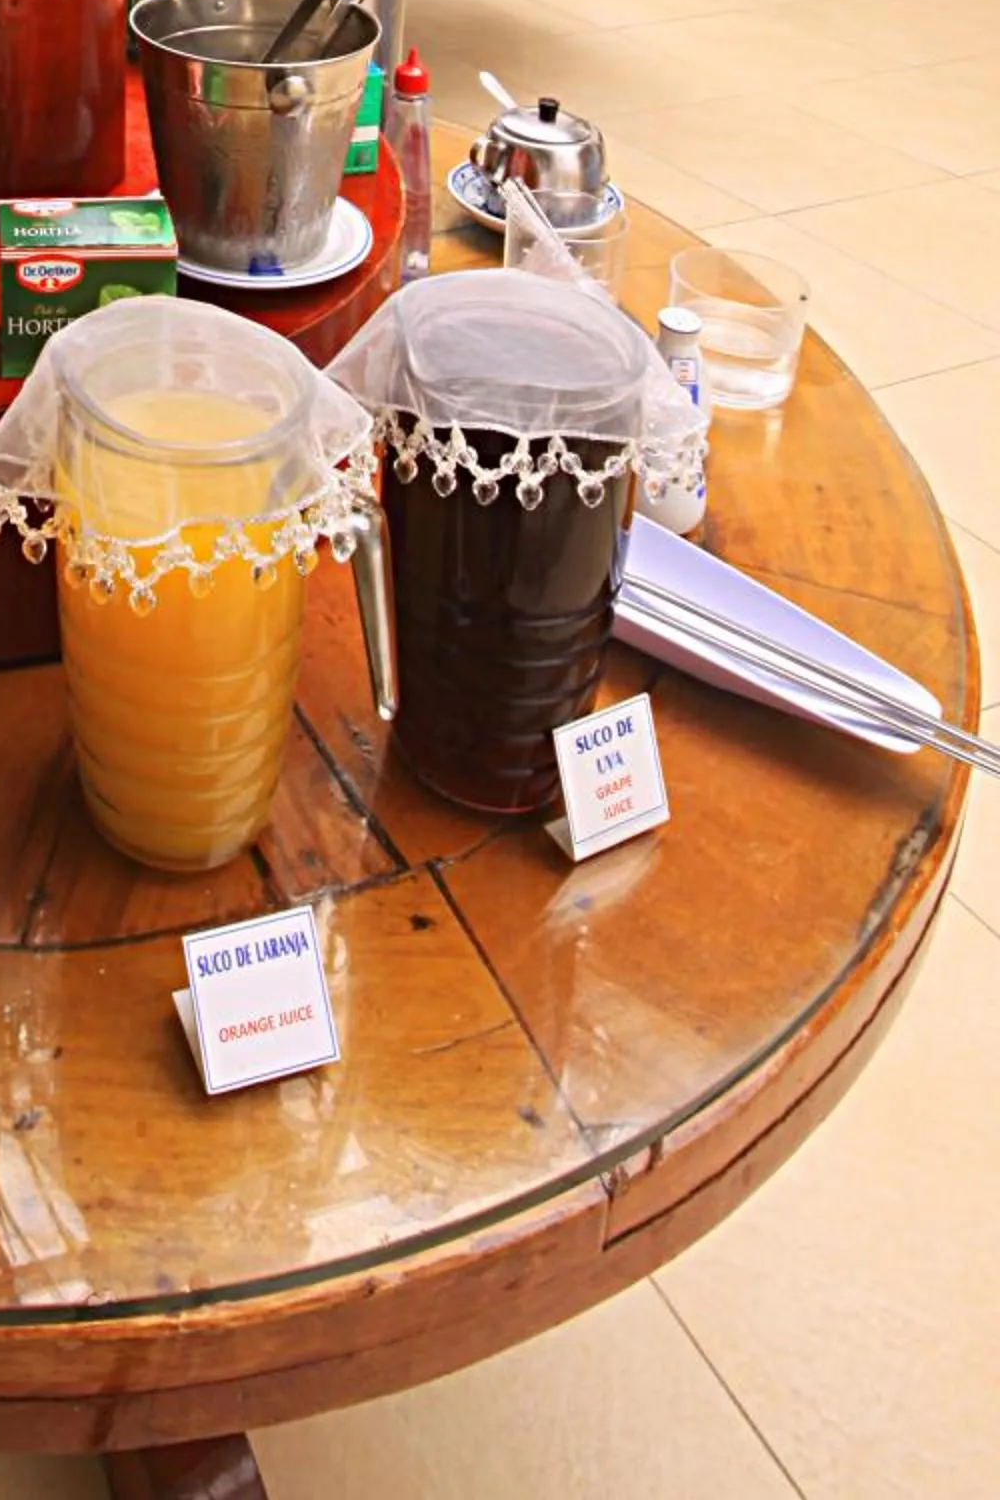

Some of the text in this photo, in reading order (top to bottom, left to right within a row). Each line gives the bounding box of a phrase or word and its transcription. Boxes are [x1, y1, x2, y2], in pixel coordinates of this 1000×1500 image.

[575, 716, 634, 755] SUCO DE
[596, 750, 625, 775] UVA
[596, 775, 633, 800] GRAPE
[604, 797, 633, 821] JUICE
[197, 930, 310, 978] SUCO DE LARANJA
[218, 1004, 314, 1043] ORANGE JUICE
